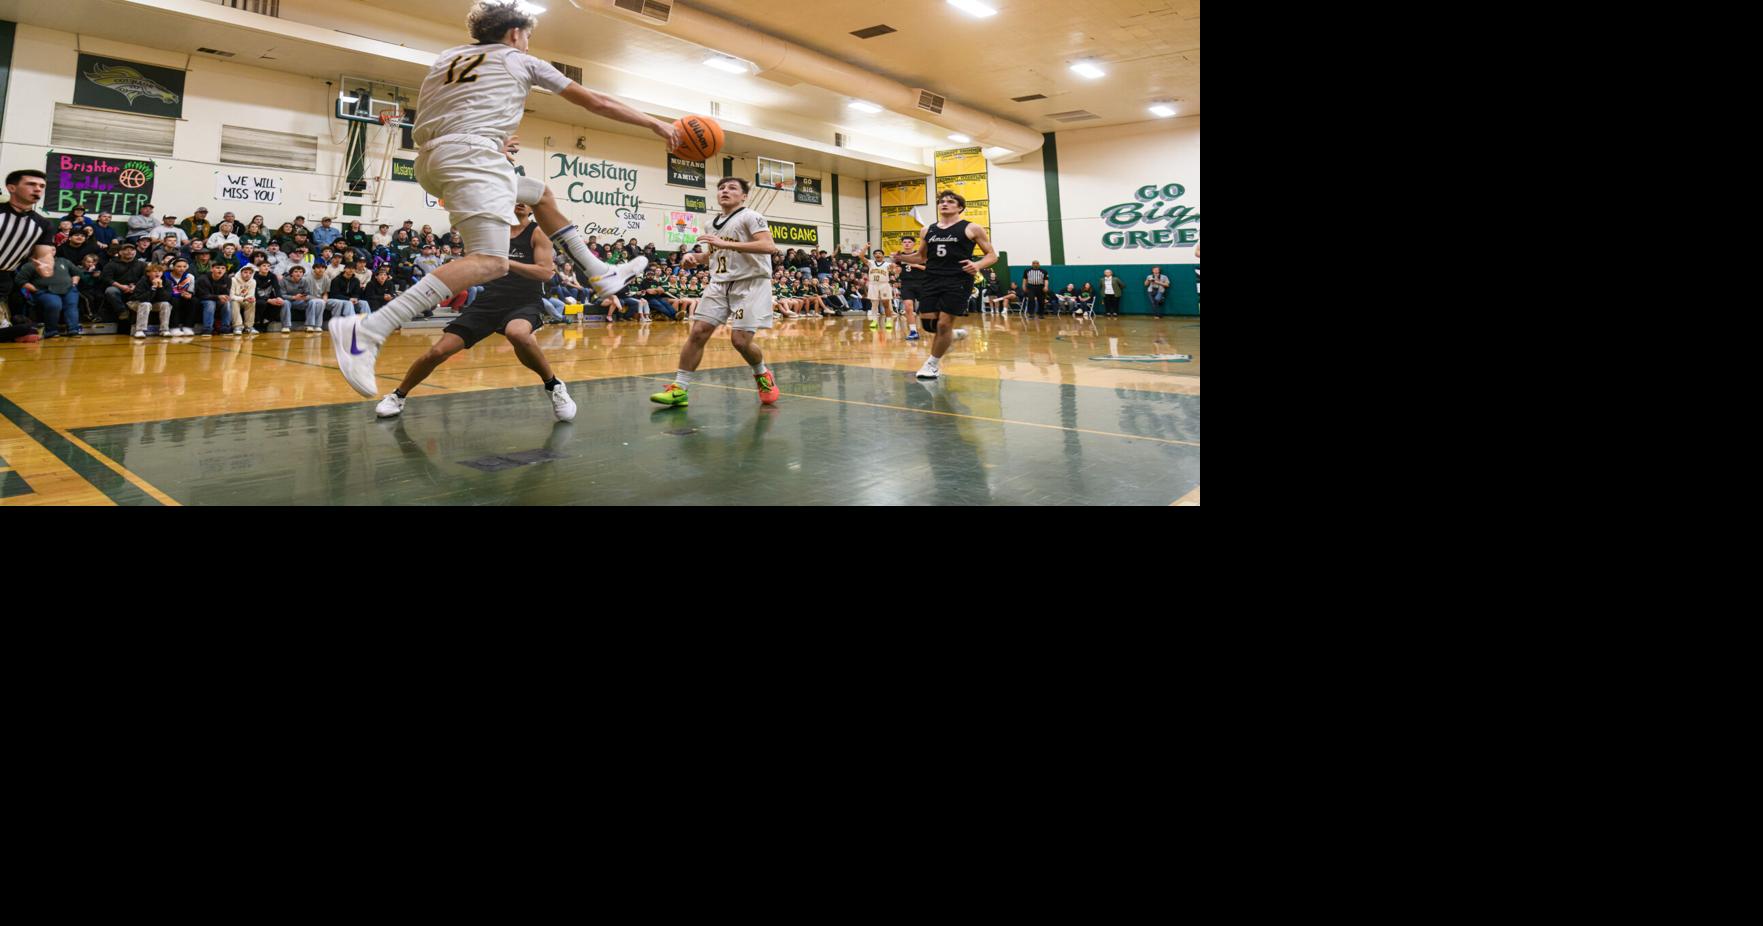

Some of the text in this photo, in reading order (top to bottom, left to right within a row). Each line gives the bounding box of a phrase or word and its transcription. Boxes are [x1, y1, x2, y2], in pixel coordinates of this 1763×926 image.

[444, 52, 486, 85] 12
[687, 119, 709, 150] Wilson
[60, 155, 120, 173] Brighter
[671, 157, 705, 169] MUSTANG
[550, 153, 638, 192] Mustang
[673, 172, 700, 182] FAMILY
[227, 174, 276, 189] WE WILL
[222, 187, 275, 202] MISS YOU
[567, 181, 639, 218] Country
[1134, 183, 1186, 202] GO
[58, 190, 148, 215] BETTER
[623, 211, 646, 221] SENIOR
[1100, 201, 1200, 230] Big
[627, 221, 640, 230] SZN
[789, 226, 818, 242] GANG
[927, 234, 958, 244] Amador
[1101, 229, 1199, 250] GREE
[936, 244, 947, 257] 5
[905, 264, 912, 272] 3
[735, 308, 744, 320] 13
